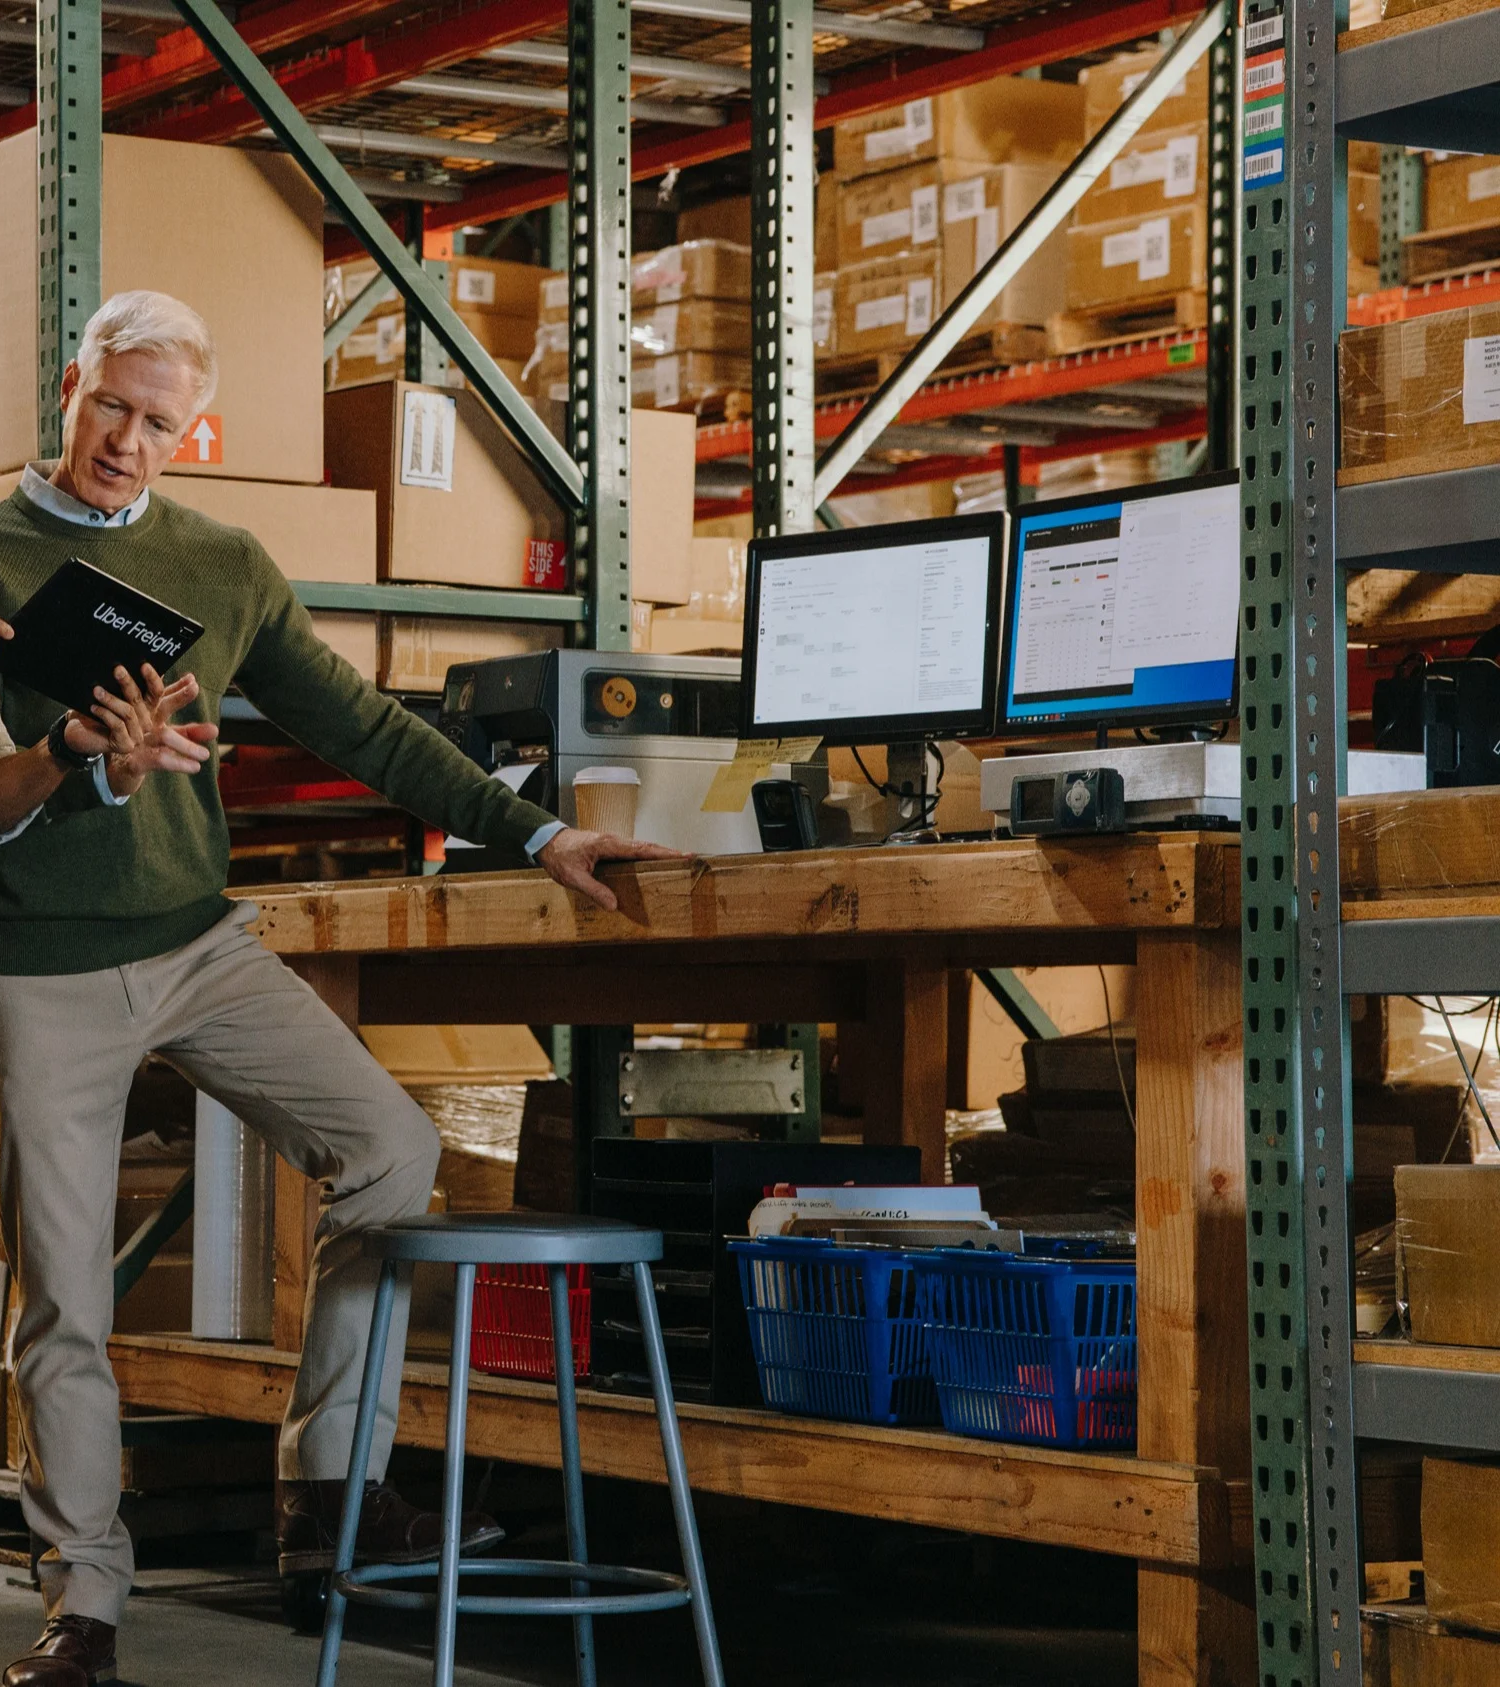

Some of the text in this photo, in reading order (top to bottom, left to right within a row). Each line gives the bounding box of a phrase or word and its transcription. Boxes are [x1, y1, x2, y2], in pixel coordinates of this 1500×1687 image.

[530, 541, 554, 559] THIS
[528, 556, 552, 574] SIDE
[534, 572, 545, 584] UP
[93, 602, 182, 657] Uber Freight
